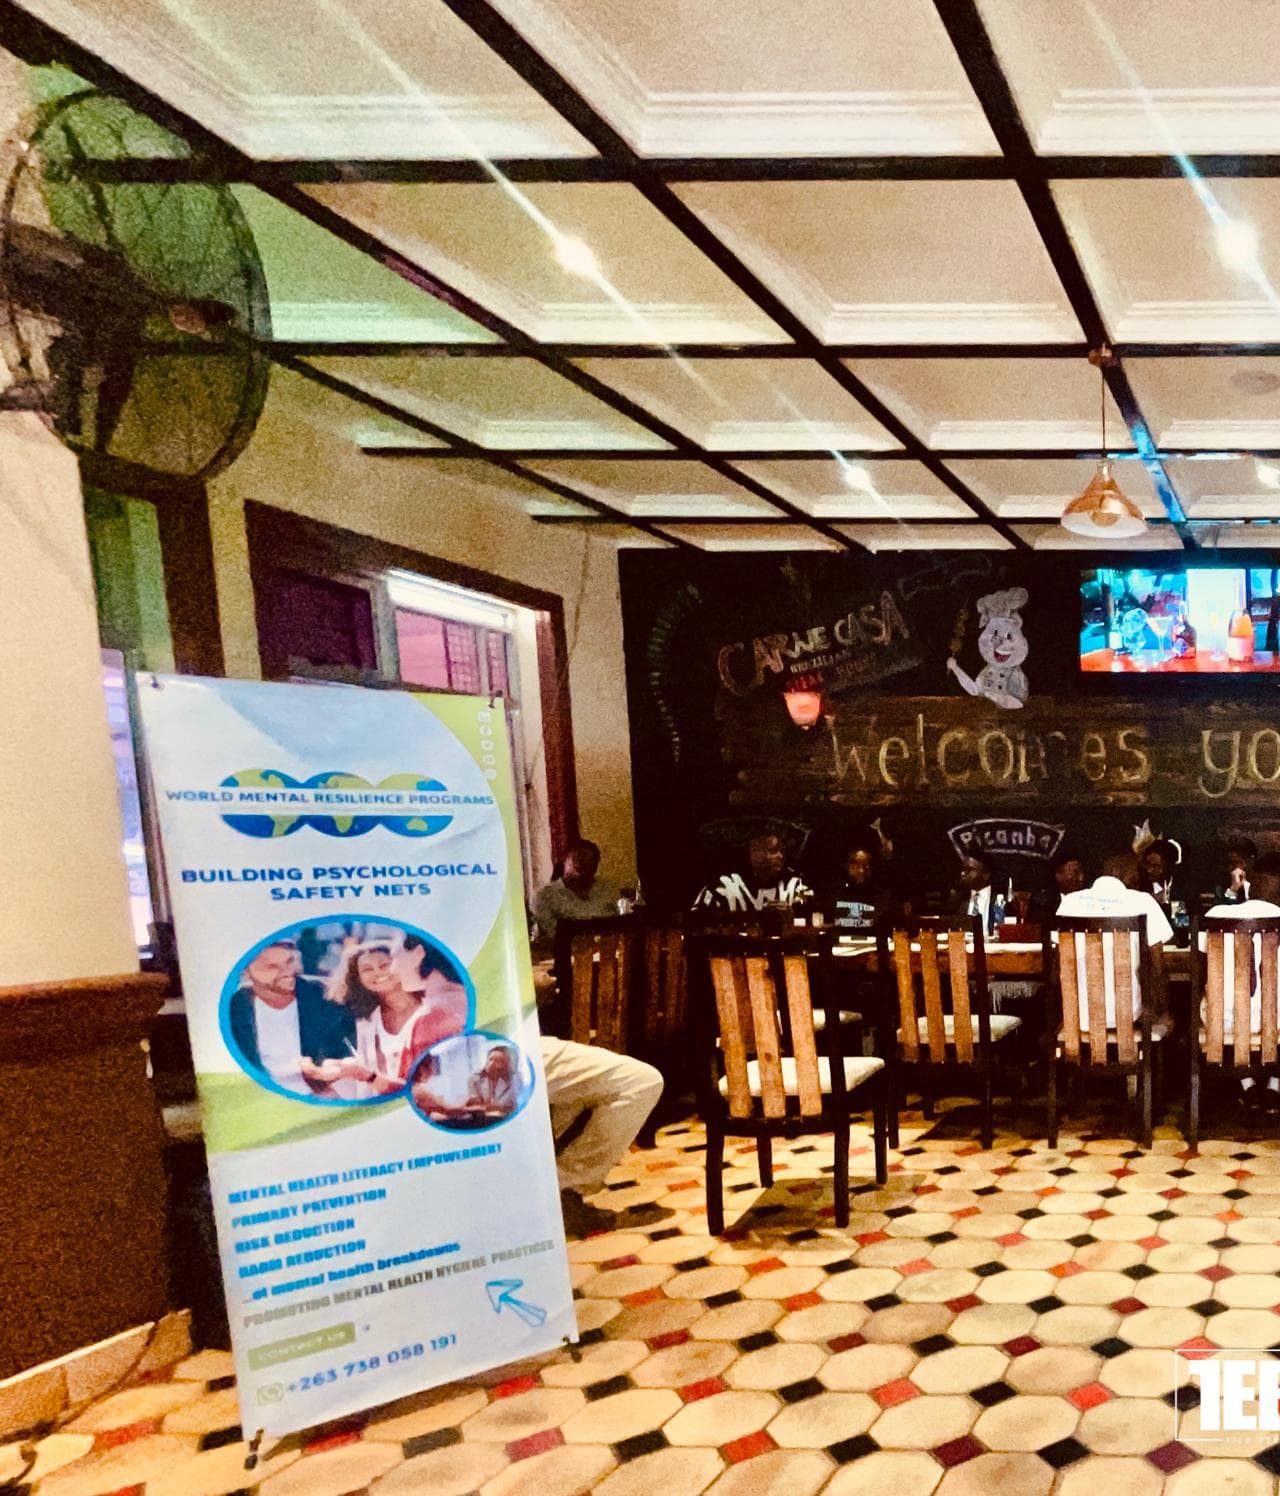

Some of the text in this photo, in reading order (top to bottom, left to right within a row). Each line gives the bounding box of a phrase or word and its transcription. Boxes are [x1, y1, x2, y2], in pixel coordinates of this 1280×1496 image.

[717, 626, 832, 698] CARNE
[833, 589, 910, 647] CASA
[166, 790, 494, 806] WORLD MENTAL RESILIENCE PROGRAMS
[181, 863, 498, 882] BUILDING PSYCHOLOGICAL
[270, 883, 431, 901] SAFETY NETS
[228, 1142, 502, 1205] MENTAL HEALTH LITERACY EMPOWERMENT
[232, 1187, 387, 1228] PRIMARY PREVENTION
[234, 1217, 356, 1254] RISK REDUCTION
[238, 1239, 367, 1279] HARM REDUCTION
[271, 1273, 325, 1296] mental
[328, 1261, 375, 1283] health
[377, 1242, 461, 1271] breakdowns
[243, 1239, 555, 1328] PROMOTING MENTAL HEALTH HYGIENE PRACTICES
[288, 1333, 457, 1393] +263 738 058 191
